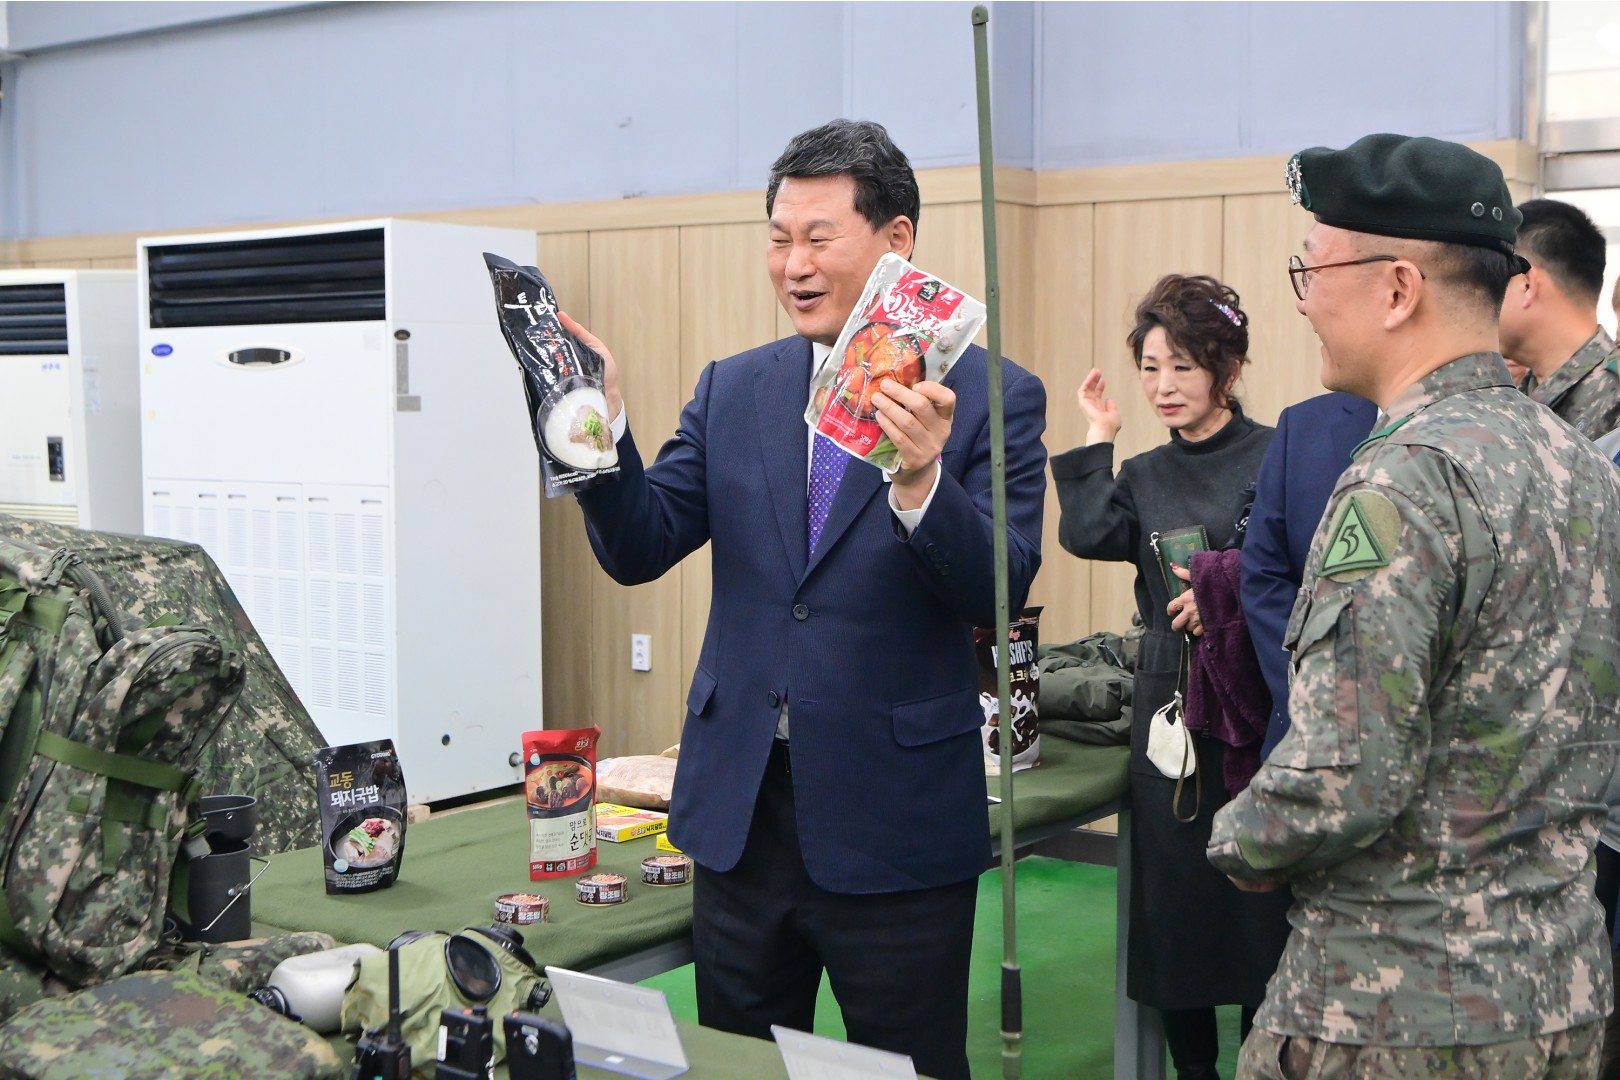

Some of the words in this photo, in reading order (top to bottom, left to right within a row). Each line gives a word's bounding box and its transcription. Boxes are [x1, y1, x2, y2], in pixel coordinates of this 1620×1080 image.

[991, 640, 1033, 668] HSHEY'S
[330, 771, 354, 790] 교동
[331, 785, 380, 808] 돼지국밥
